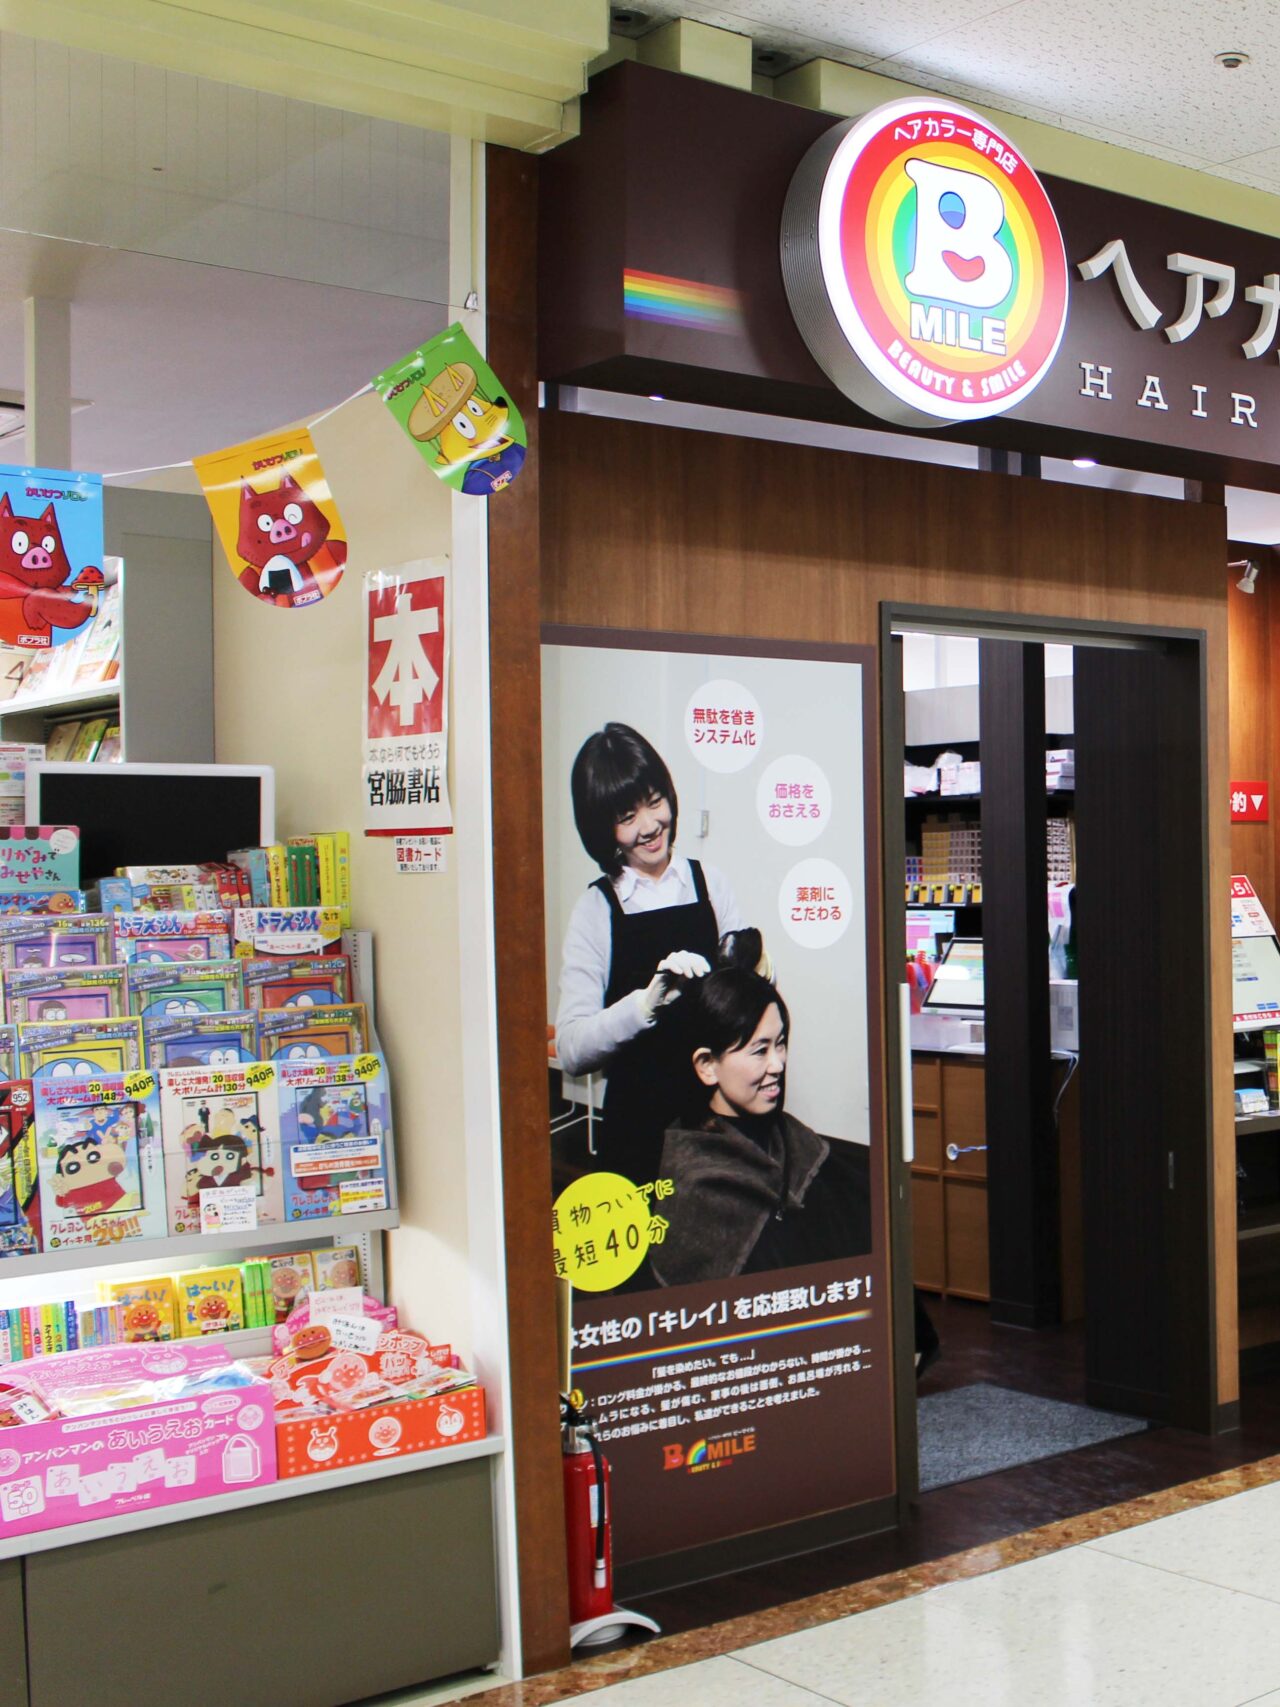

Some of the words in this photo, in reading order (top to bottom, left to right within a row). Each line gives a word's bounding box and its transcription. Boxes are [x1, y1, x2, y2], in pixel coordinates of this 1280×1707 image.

[894, 118, 1018, 174] ヘアカラー専門店
[904, 158, 1014, 309] B
[910, 301, 1007, 356] MILE
[887, 339, 956, 395] BEAUTY
[962, 378, 974, 398] &
[981, 359, 1027, 397] SMILE
[1079, 361, 1258, 428] HAIR
[373, 594, 439, 728] 本
[693, 708, 755, 726] 無駄を省き
[694, 728, 756, 746] システム化
[368, 765, 440, 806] 宮脇書店
[774, 783, 814, 799] 価格を
[768, 803, 821, 819] おさえる
[396, 847, 442, 862] 図書カード
[796, 886, 835, 902] 薬剤に
[257, 910, 321, 933] ドラえもん
[791, 906, 842, 921] こだわる
[246, 1067, 275, 1087] 940円
[354, 1059, 381, 1078] 940円
[125, 1076, 155, 1097] 940円
[172, 1083, 246, 1096] 大ボリューム計130分
[13, 1093, 27, 1103] 952
[50, 1217, 125, 1234] クレヨンしんちゃん
[22, 1440, 105, 1464] アンパンマンの
[108, 1421, 201, 1449] あいうえお
[204, 1415, 234, 1429] カード
[707, 1434, 756, 1460] MILE
